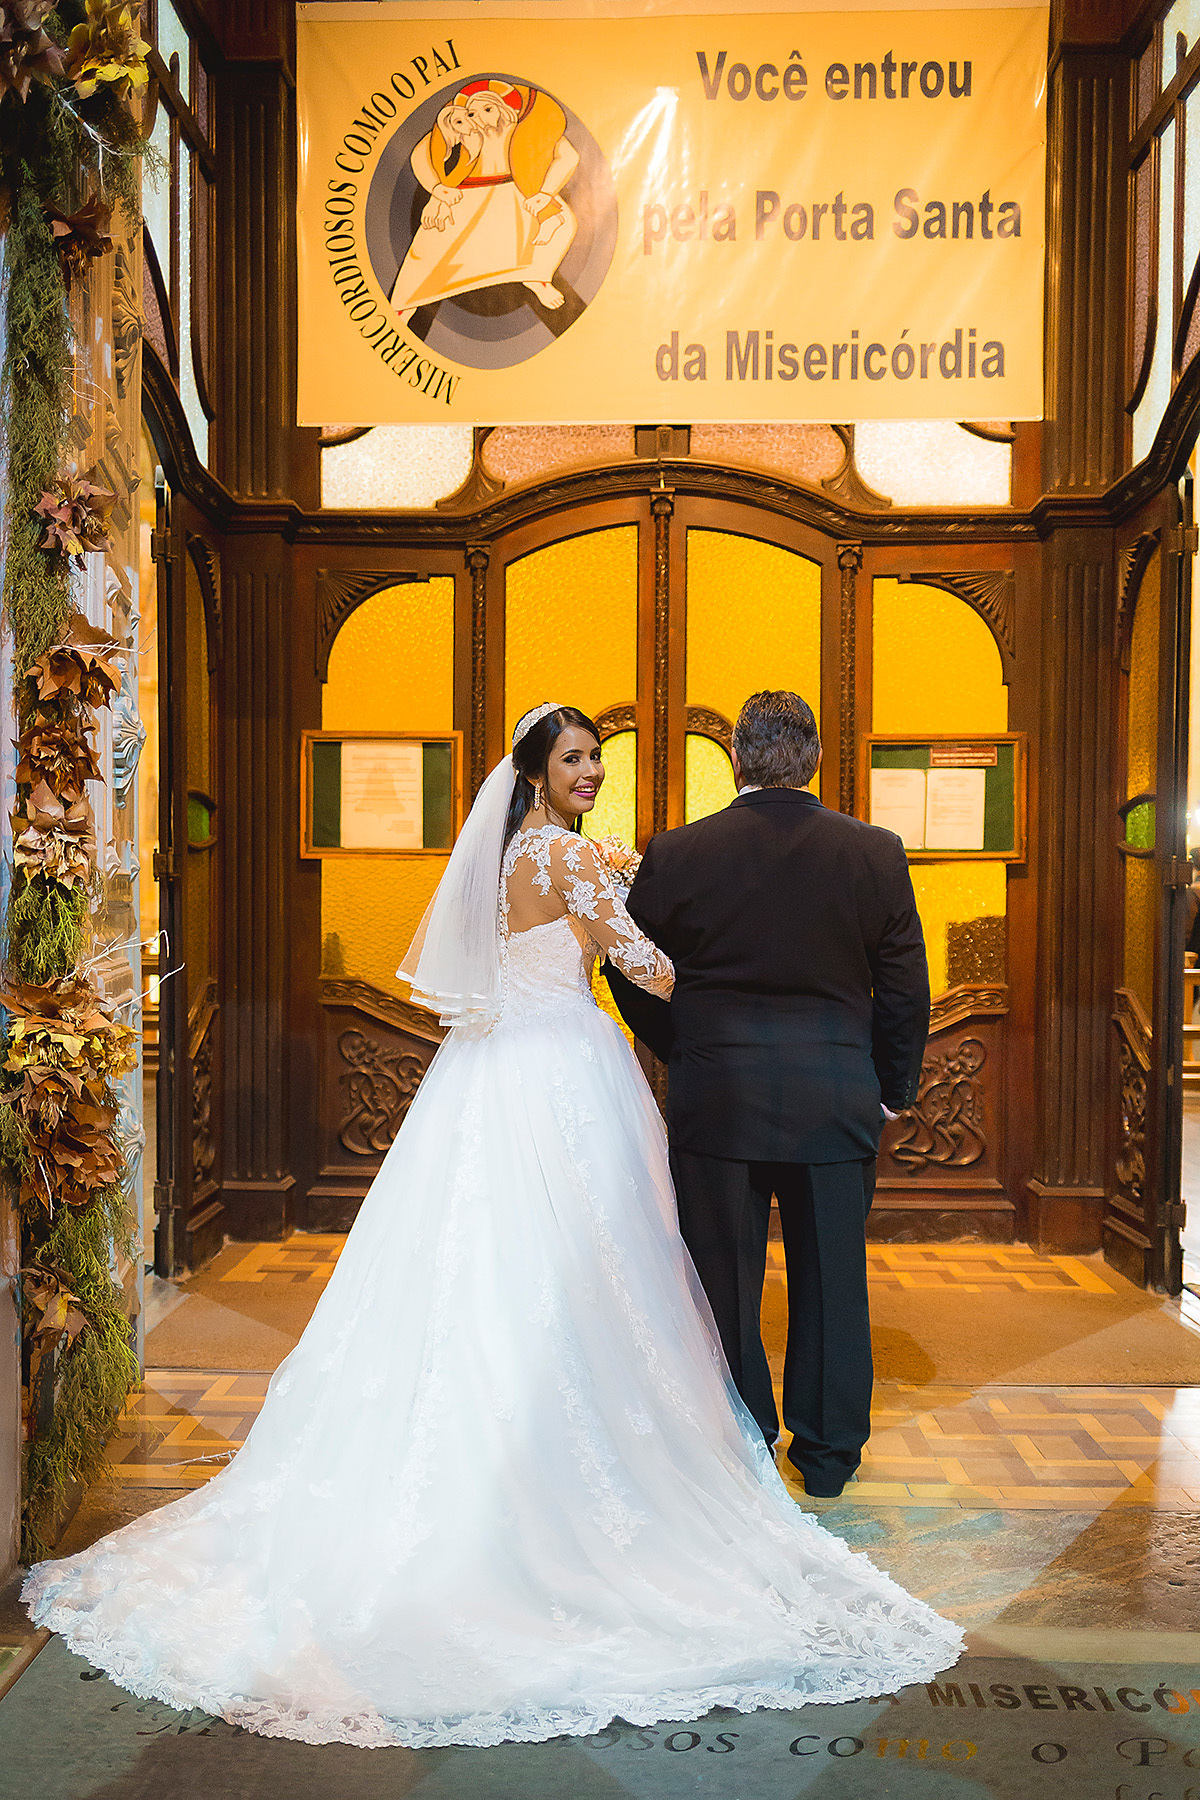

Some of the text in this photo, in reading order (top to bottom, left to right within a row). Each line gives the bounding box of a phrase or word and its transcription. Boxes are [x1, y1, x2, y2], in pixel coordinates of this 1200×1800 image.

[695, 50, 972, 101] Você entrou
[324, 39, 462, 405] MISERICORDIOSOS COMO O PAI
[643, 188, 1022, 255] pela Porta Santa
[655, 328, 1006, 382] da Misericórdia
